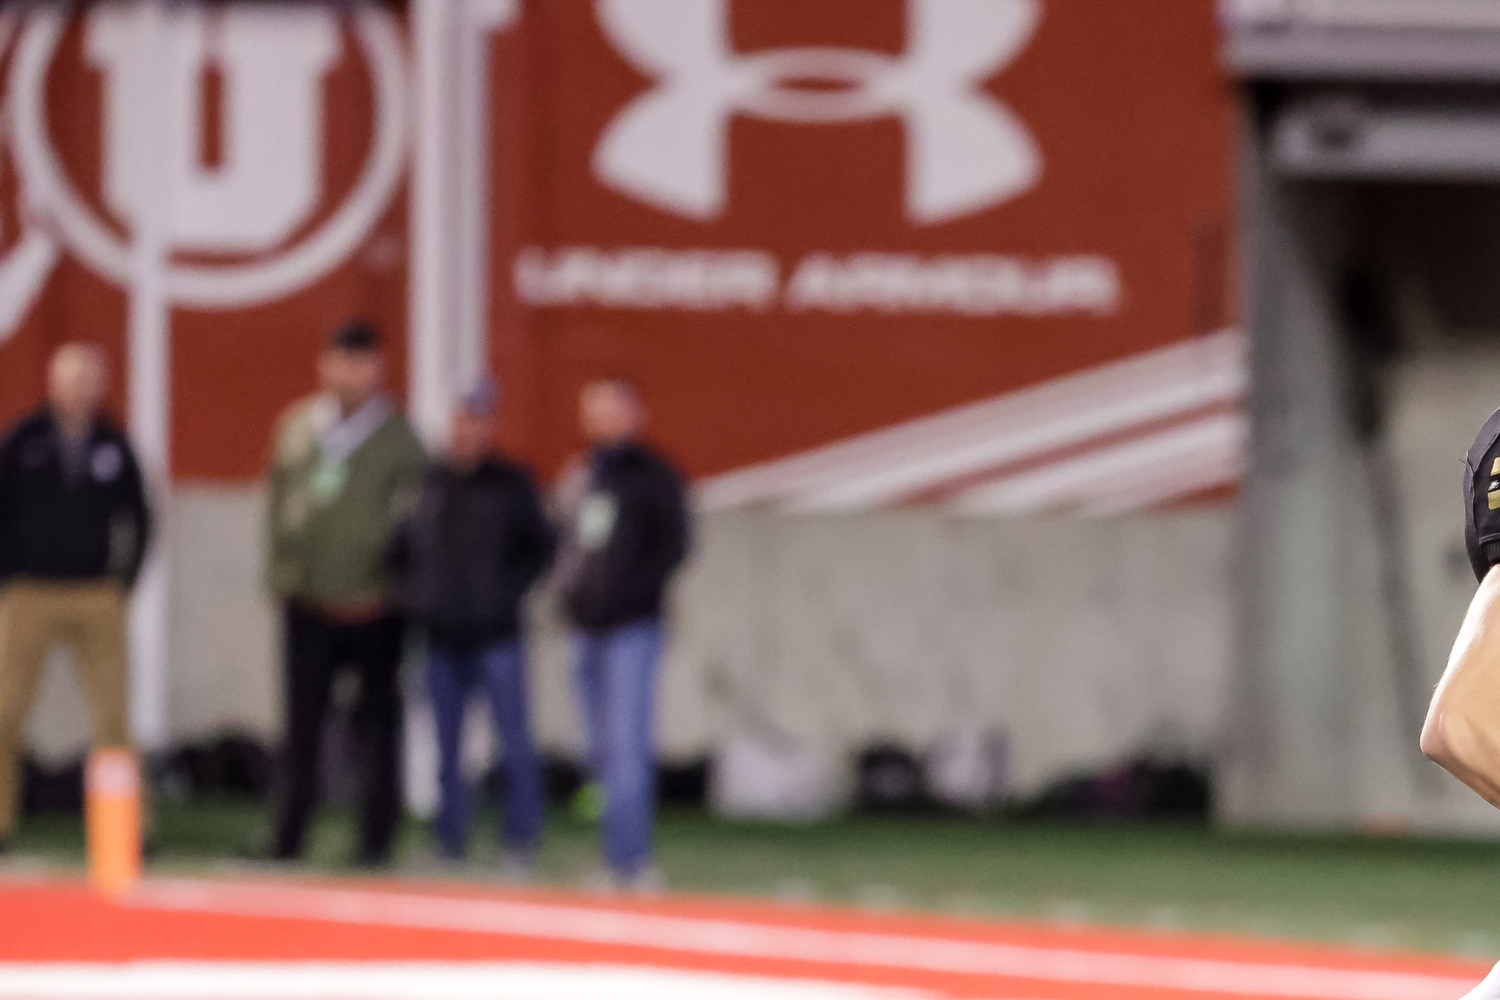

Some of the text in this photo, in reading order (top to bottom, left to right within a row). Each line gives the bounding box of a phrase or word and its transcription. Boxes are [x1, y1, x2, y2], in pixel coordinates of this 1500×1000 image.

[86, 2, 343, 249] U
[511, 247, 1121, 315] UNDER ARMOUR
